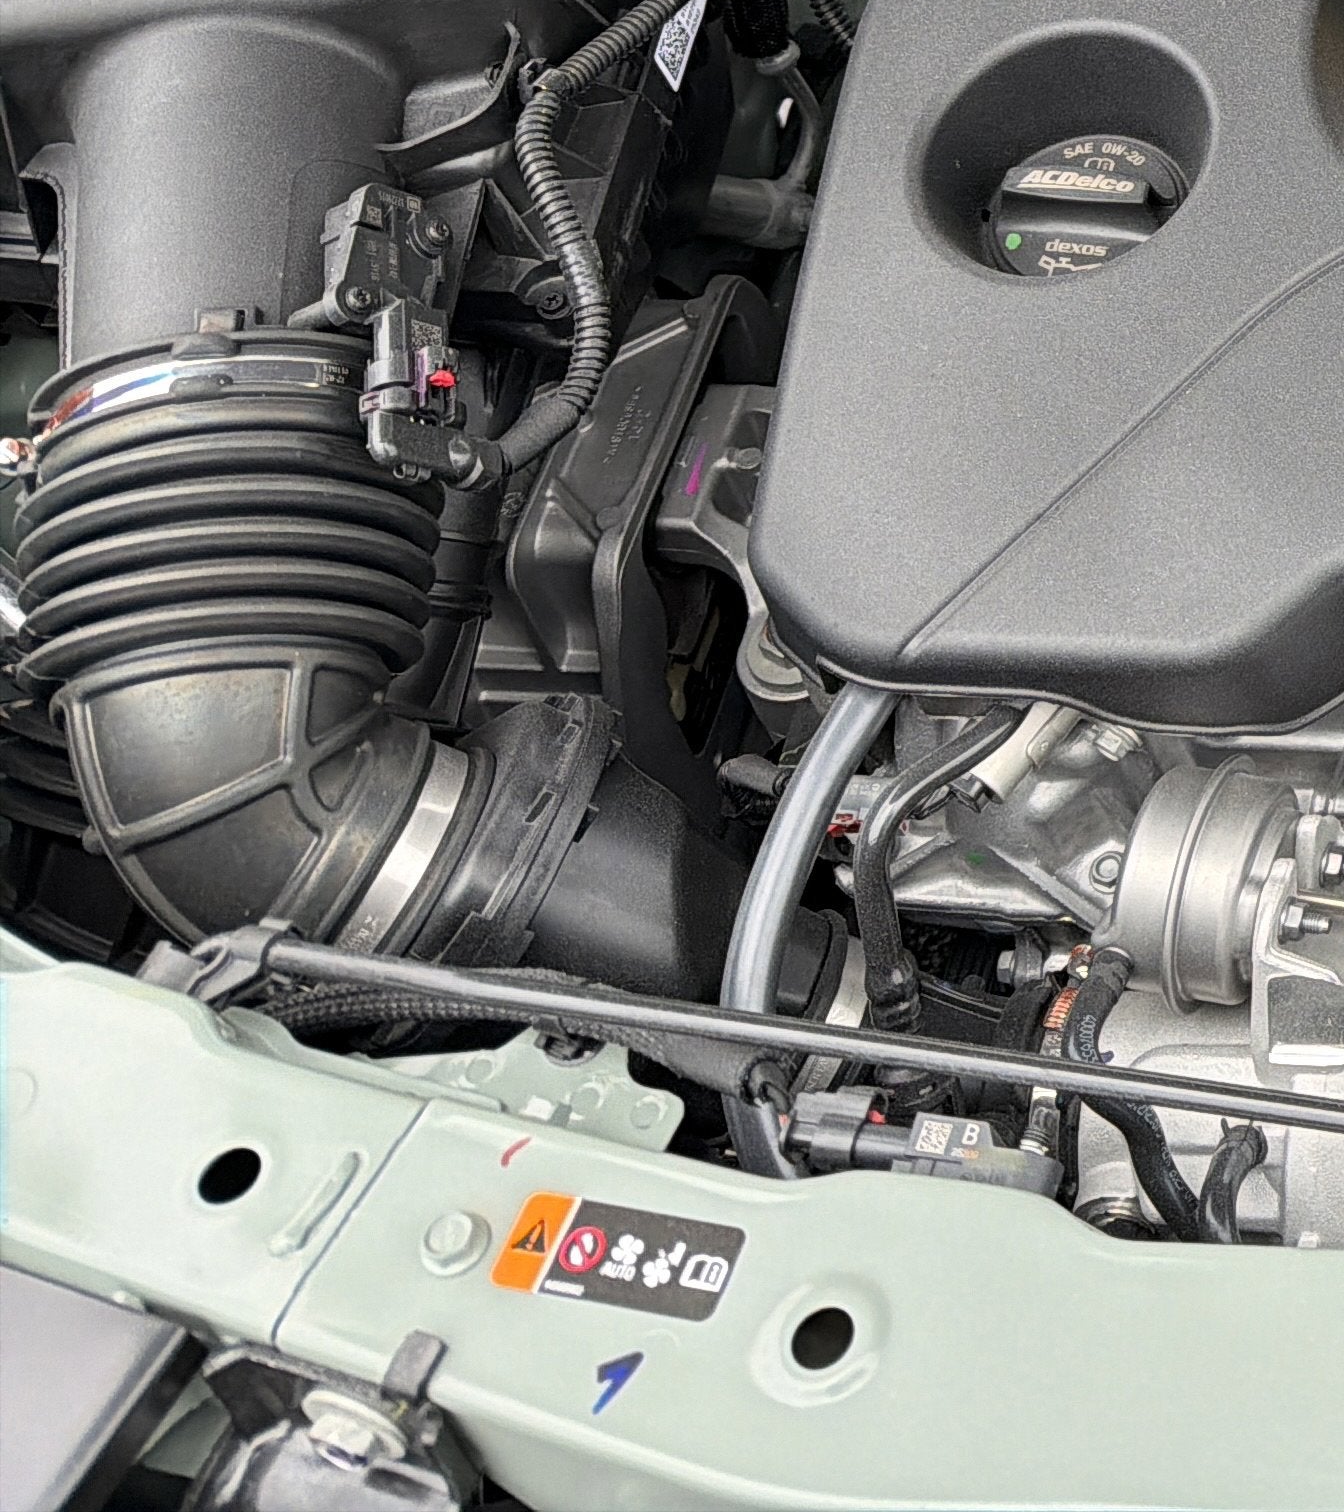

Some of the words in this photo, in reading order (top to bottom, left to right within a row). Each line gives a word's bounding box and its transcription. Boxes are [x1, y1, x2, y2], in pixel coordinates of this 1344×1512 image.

[1063, 141, 1095, 159] SAE
[1101, 141, 1146, 166] 0W-20
[1019, 169, 1136, 192] ACDelco
[1044, 238, 1110, 257] dexos
[962, 1122, 981, 1146] B
[598, 1262, 637, 1282] AUTO
